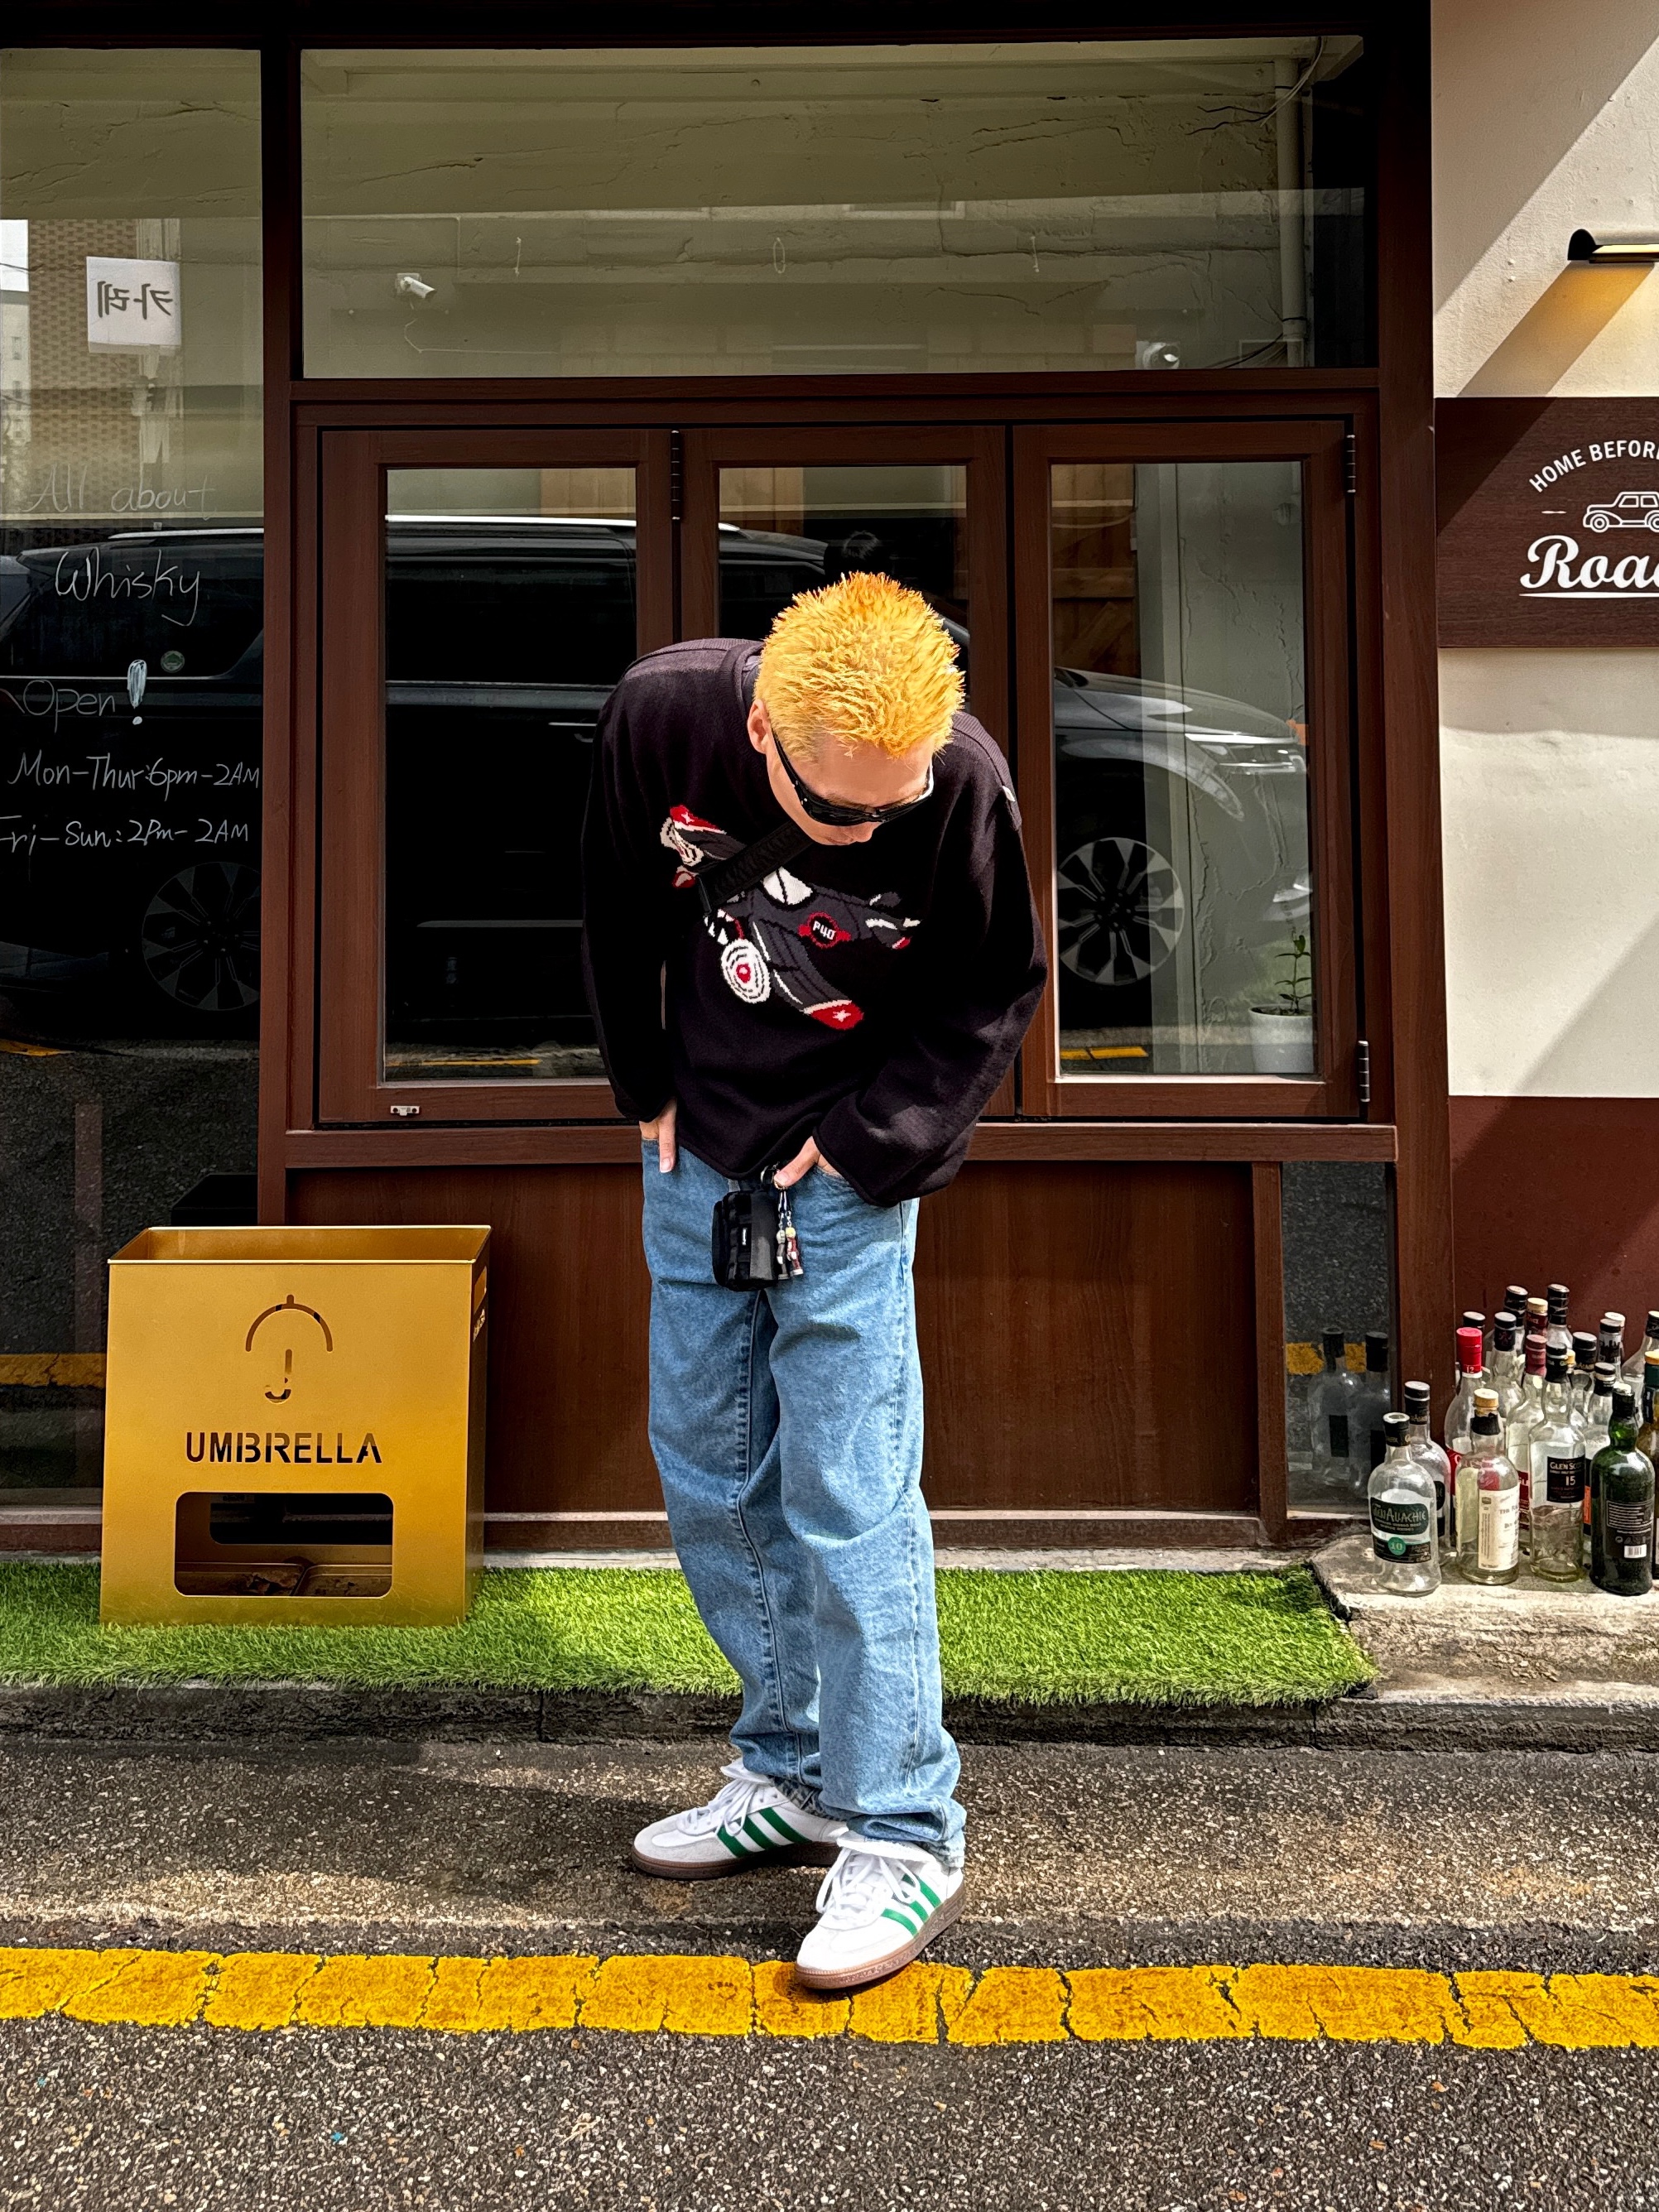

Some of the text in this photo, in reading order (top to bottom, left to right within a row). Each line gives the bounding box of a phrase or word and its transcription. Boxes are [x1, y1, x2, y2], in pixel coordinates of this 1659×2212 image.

[22, 463, 217, 521] All about
[1529, 449, 1586, 493] HOME
[55, 546, 200, 627] Whisky
[1520, 535, 1659, 589] Roa
[186, 1432, 382, 1464] UMBRELLA
[1565, 1475, 1576, 1486] 15
